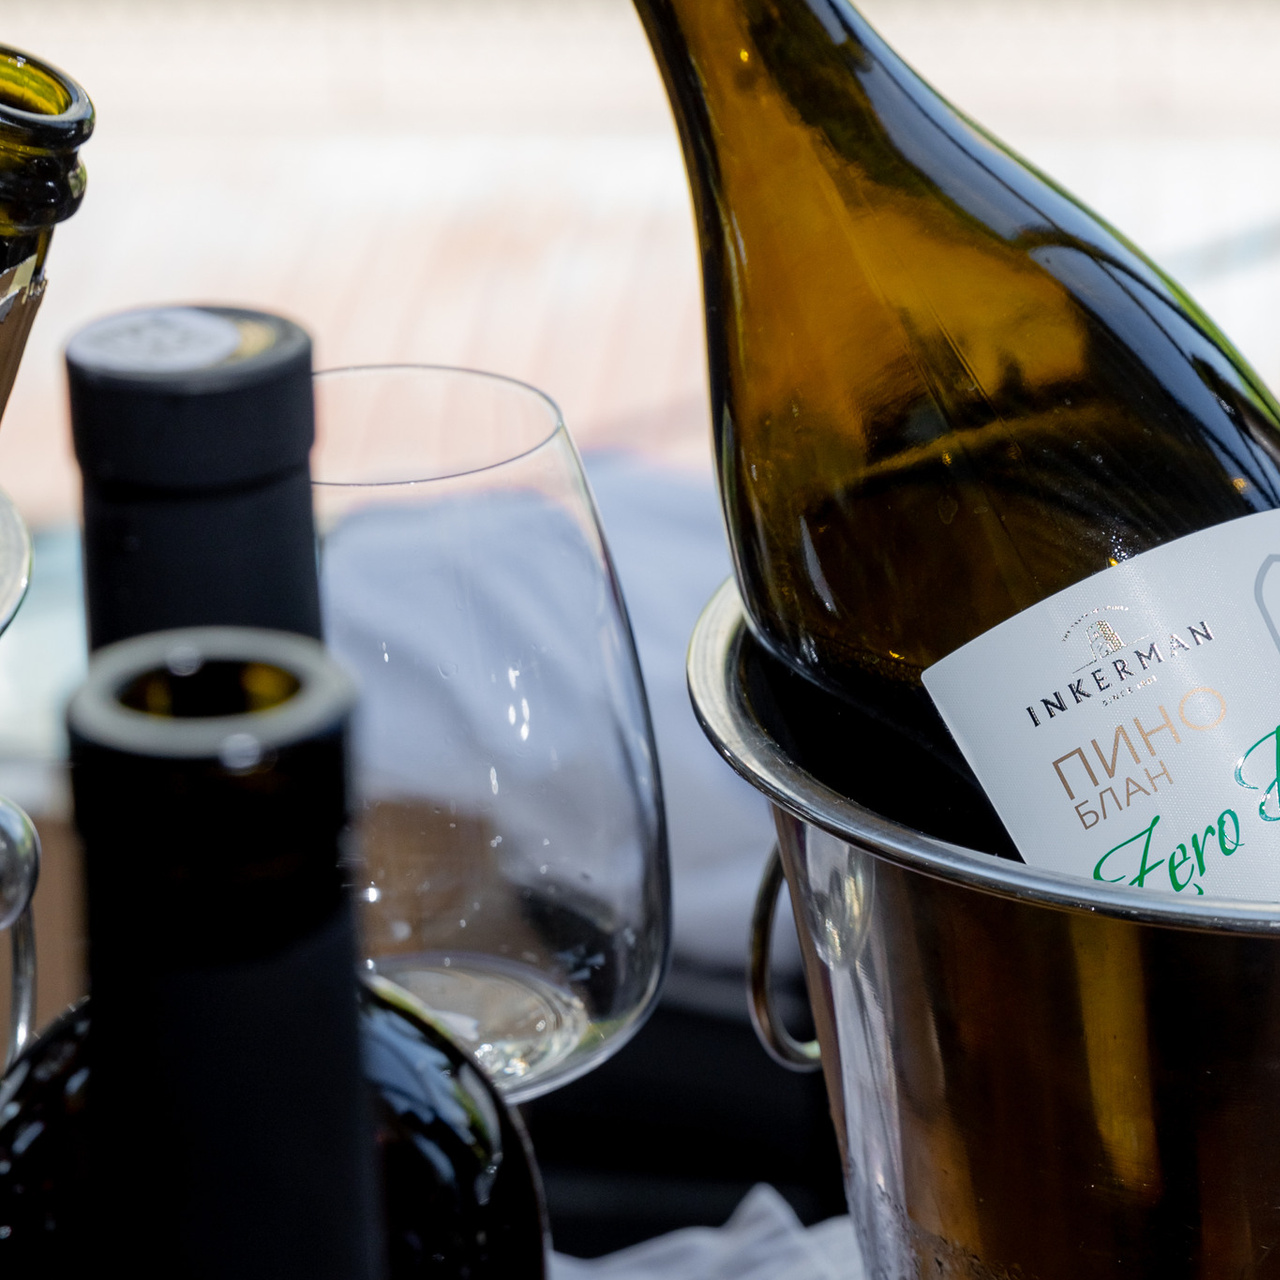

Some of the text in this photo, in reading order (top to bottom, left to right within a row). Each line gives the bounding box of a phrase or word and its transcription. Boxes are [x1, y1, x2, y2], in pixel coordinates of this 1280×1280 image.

[1026, 621, 1214, 727] INKERMAN
[1052, 686, 1226, 790] ПИНО
[1074, 760, 1173, 830] БЛАН
[1093, 808, 1245, 895] Zero
